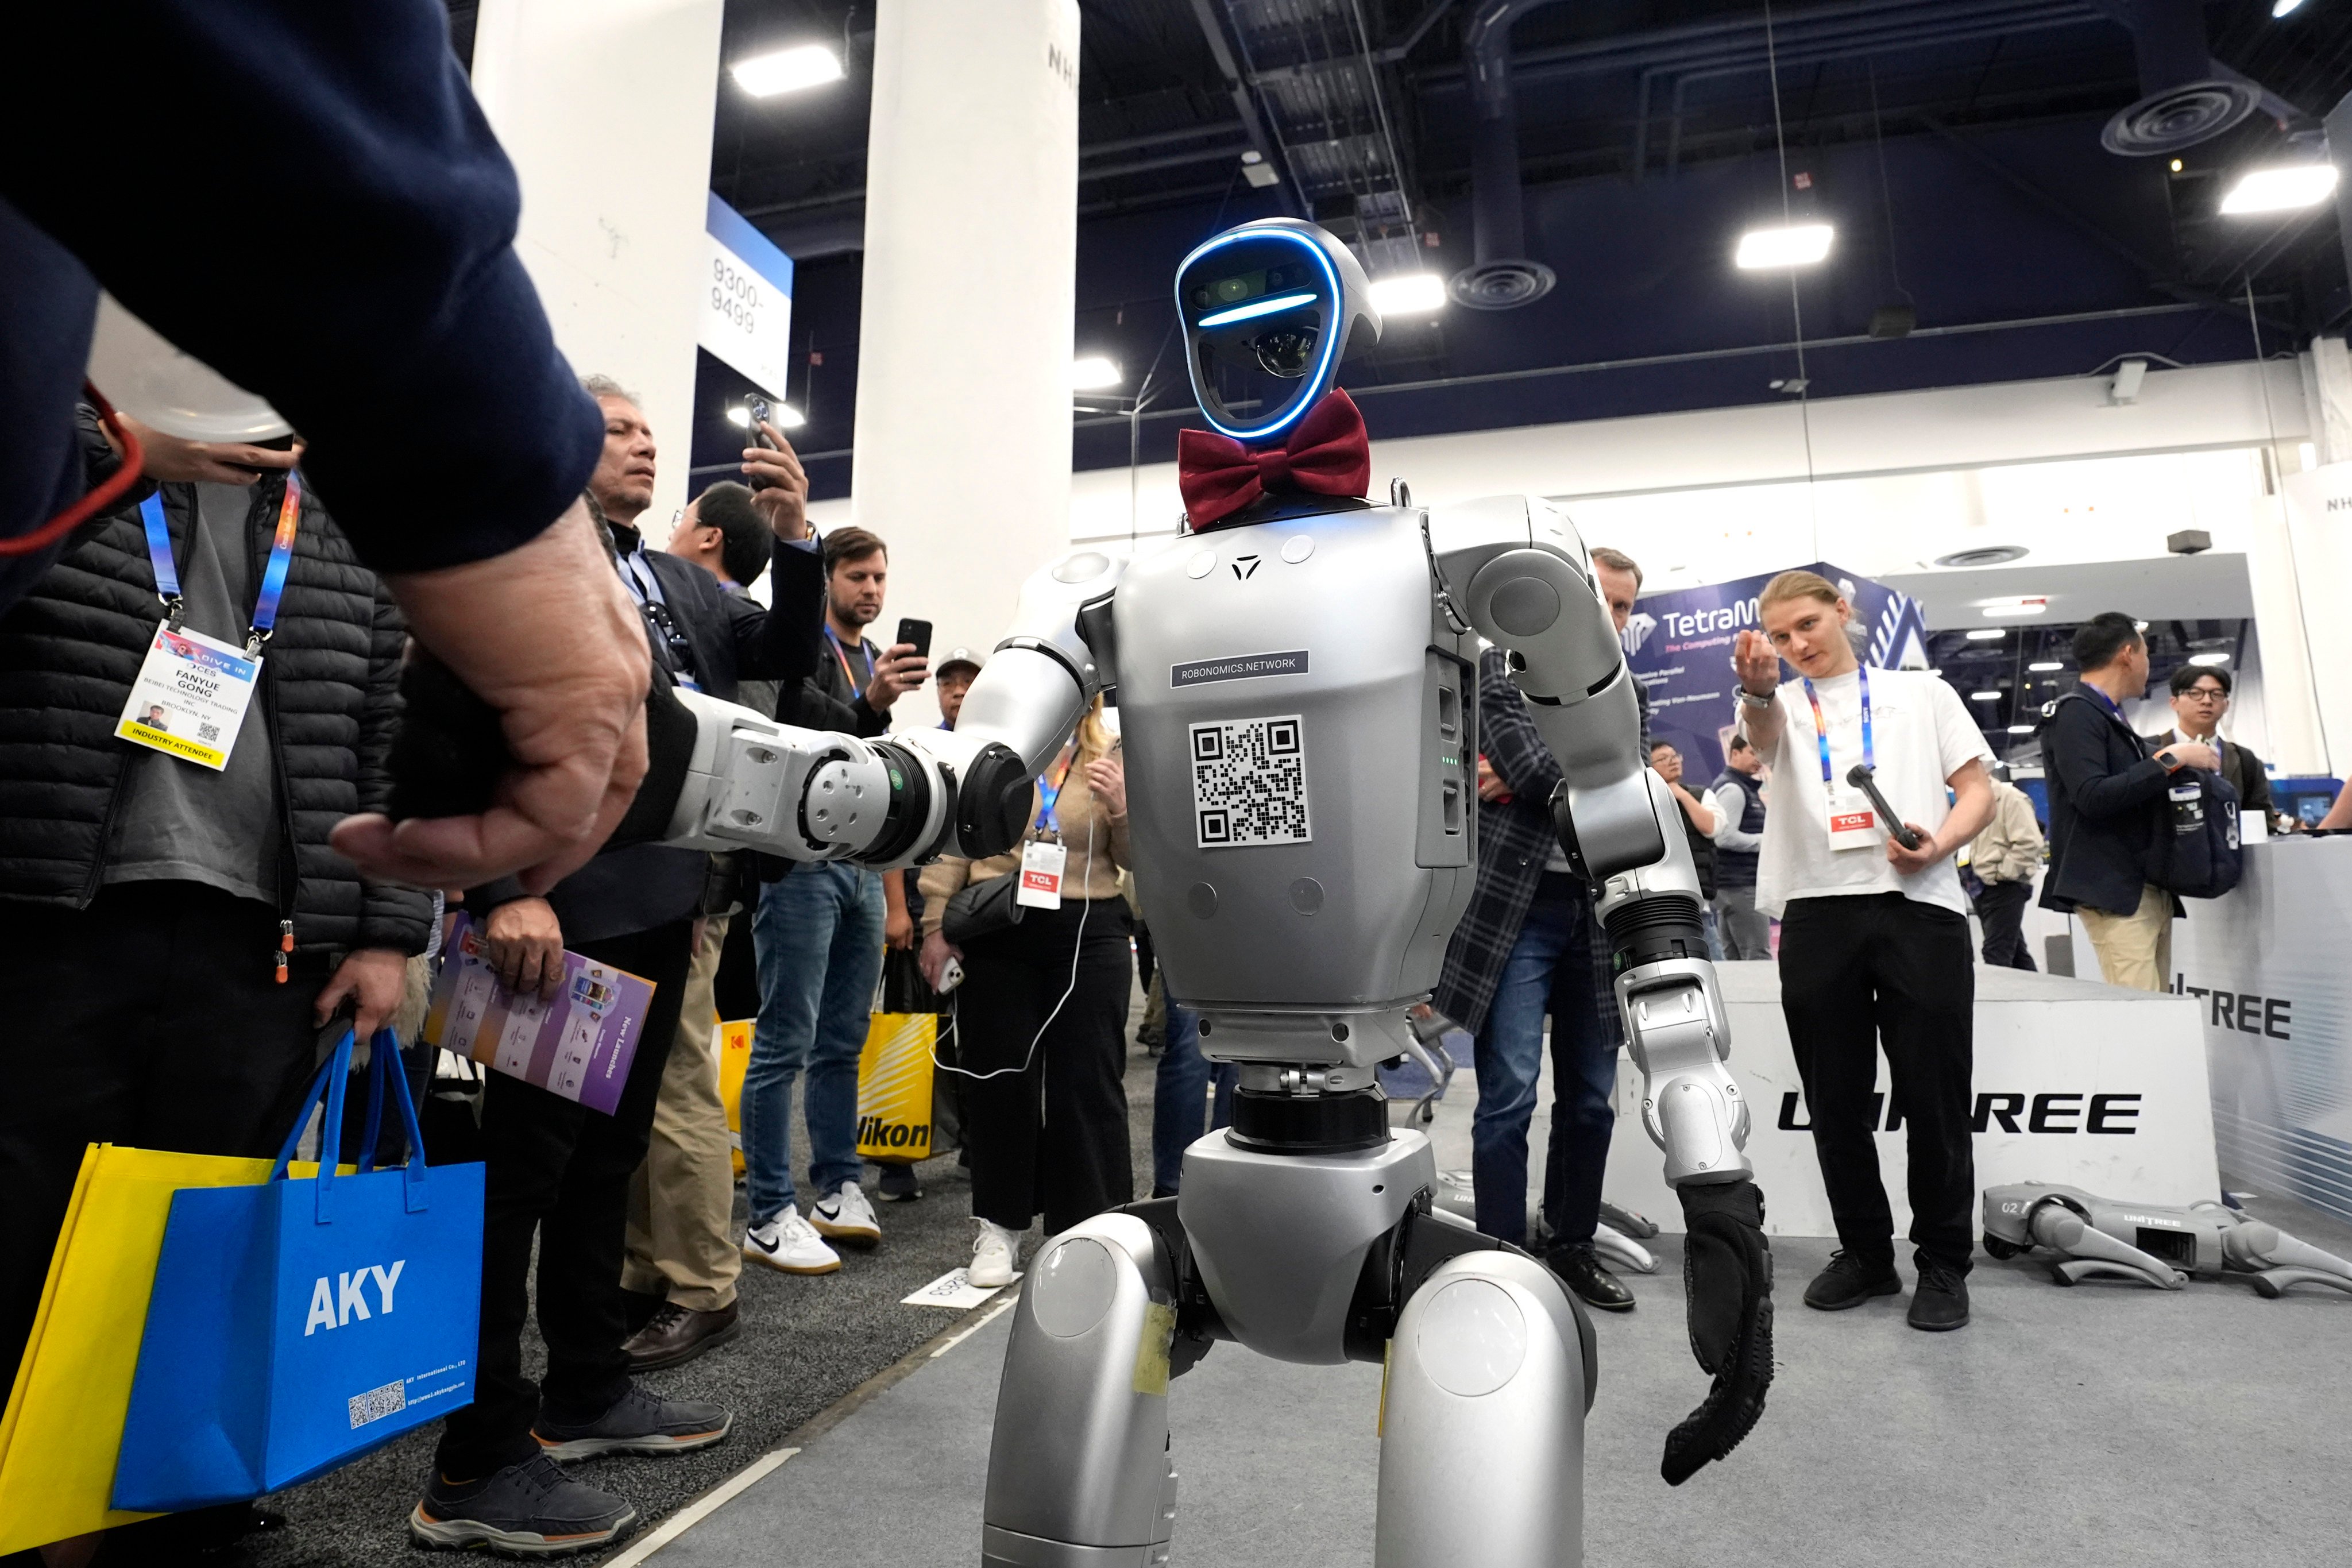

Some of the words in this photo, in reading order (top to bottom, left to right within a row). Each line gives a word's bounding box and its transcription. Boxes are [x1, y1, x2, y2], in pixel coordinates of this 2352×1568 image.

[714, 258, 763, 308] 9300-
[712, 287, 754, 334] 9499
[197, 666, 217, 677] CES
[202, 654, 230, 669] DIVE
[235, 666, 246, 675] IN
[1181, 658, 1296, 679] ROBONOMICS.NETWORK
[176, 670, 221, 692] FANYUE
[178, 680, 213, 697] GONG
[144, 677, 164, 688] BEIBEI
[167, 685, 209, 704] TECHNOLOGY
[211, 700, 238, 715] TRADING
[132, 728, 173, 747] INDUSTRY
[173, 743, 214, 760] ATTENDEE
[1838, 816, 1866, 825] TCL
[1030, 874, 1052, 886] TCL
[619, 1016, 632, 1038] New
[605, 1038, 625, 1079] Launches
[2124, 1214, 2181, 1227] UNITREE
[304, 1260, 405, 1337] AKY
[417, 1365, 447, 1380] International
